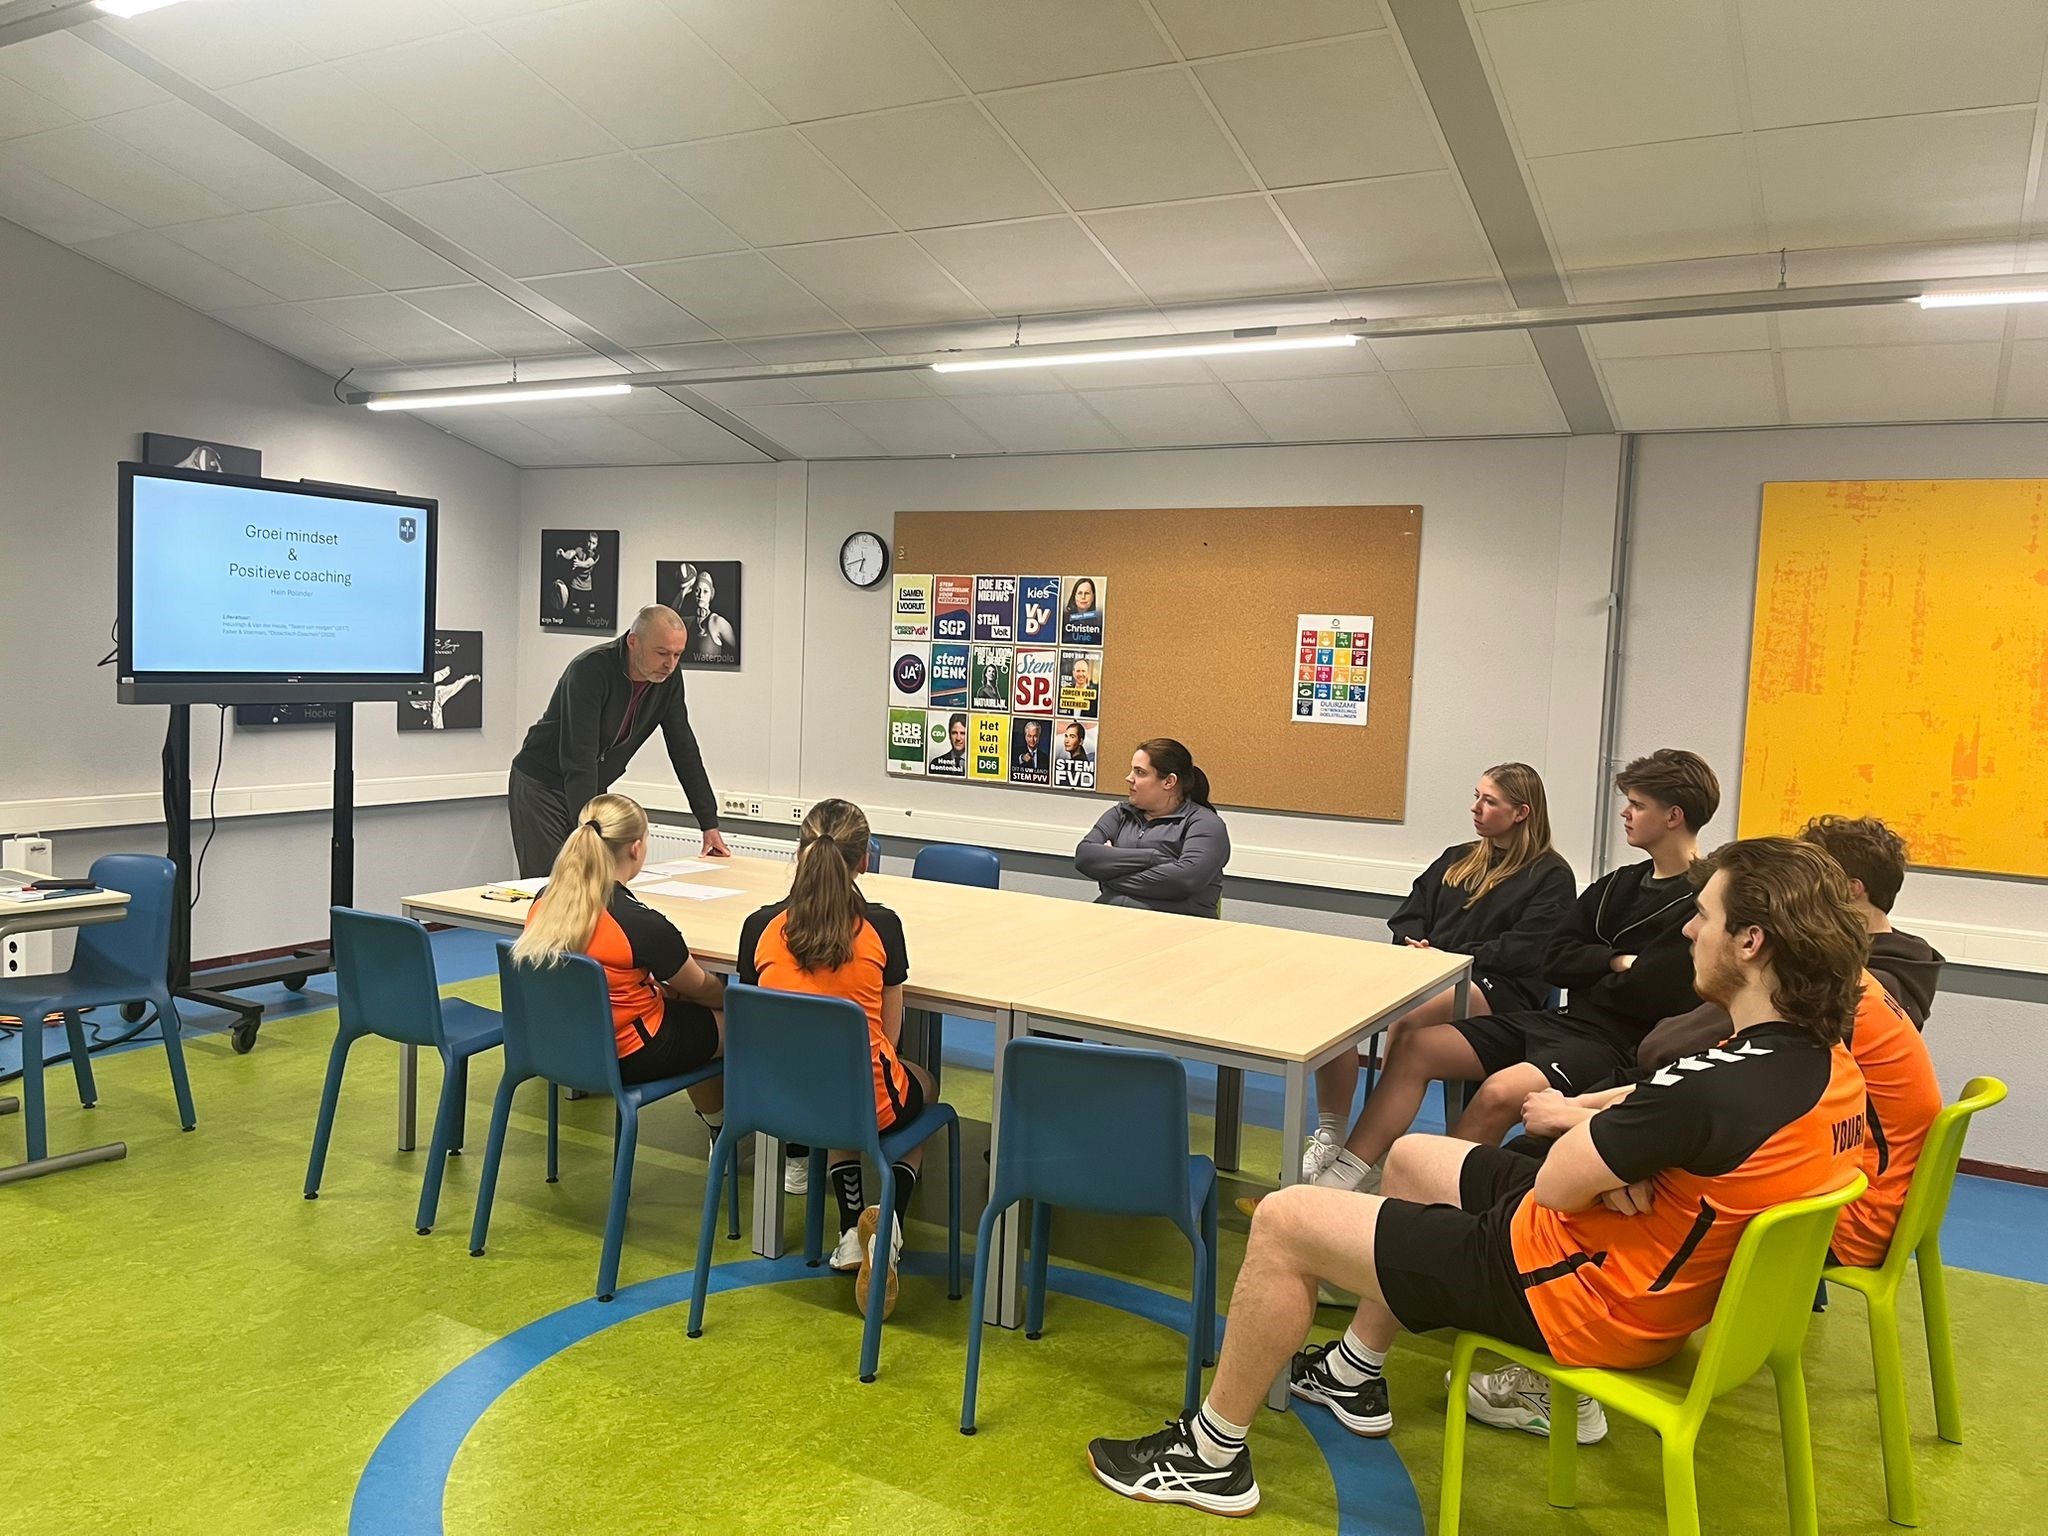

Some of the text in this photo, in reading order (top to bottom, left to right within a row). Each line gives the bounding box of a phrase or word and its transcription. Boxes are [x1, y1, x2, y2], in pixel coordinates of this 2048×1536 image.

[245, 524, 338, 545] Groei mindset
[288, 548, 297, 561] &
[229, 563, 351, 587] Positieve coaching
[979, 579, 994, 590] DOE
[902, 589, 924, 597] SAMEN
[978, 590, 1010, 602] NIEUWS
[1027, 587, 1050, 599] kies
[900, 602, 926, 610] VOORUIT
[586, 616, 609, 628] Rugby
[977, 613, 1000, 626] STEM
[939, 619, 966, 636] SGP
[993, 628, 1009, 637] Volt
[1065, 623, 1100, 634] Christen
[1072, 633, 1092, 642] Unie
[693, 652, 735, 663] Waterpolo
[935, 652, 965, 666] stem
[1017, 654, 1054, 674] Stem
[932, 666, 966, 680] DENK
[1016, 676, 1052, 707] SP.
[1062, 688, 1095, 698] ZORGEN VOOR
[1320, 701, 1357, 709] DUURZAME
[304, 708, 336, 718] Hocke
[893, 722, 921, 737] BBB
[980, 720, 999, 731] Het
[893, 736, 920, 745] LEVERT
[980, 732, 998, 742] kan
[979, 744, 998, 754] wél
[930, 764, 963, 773] Bontenbal
[979, 760, 997, 770] D66
[1055, 758, 1094, 773] STEM
[1012, 772, 1048, 782] STEM PVV
[1055, 770, 1094, 787] FVD
